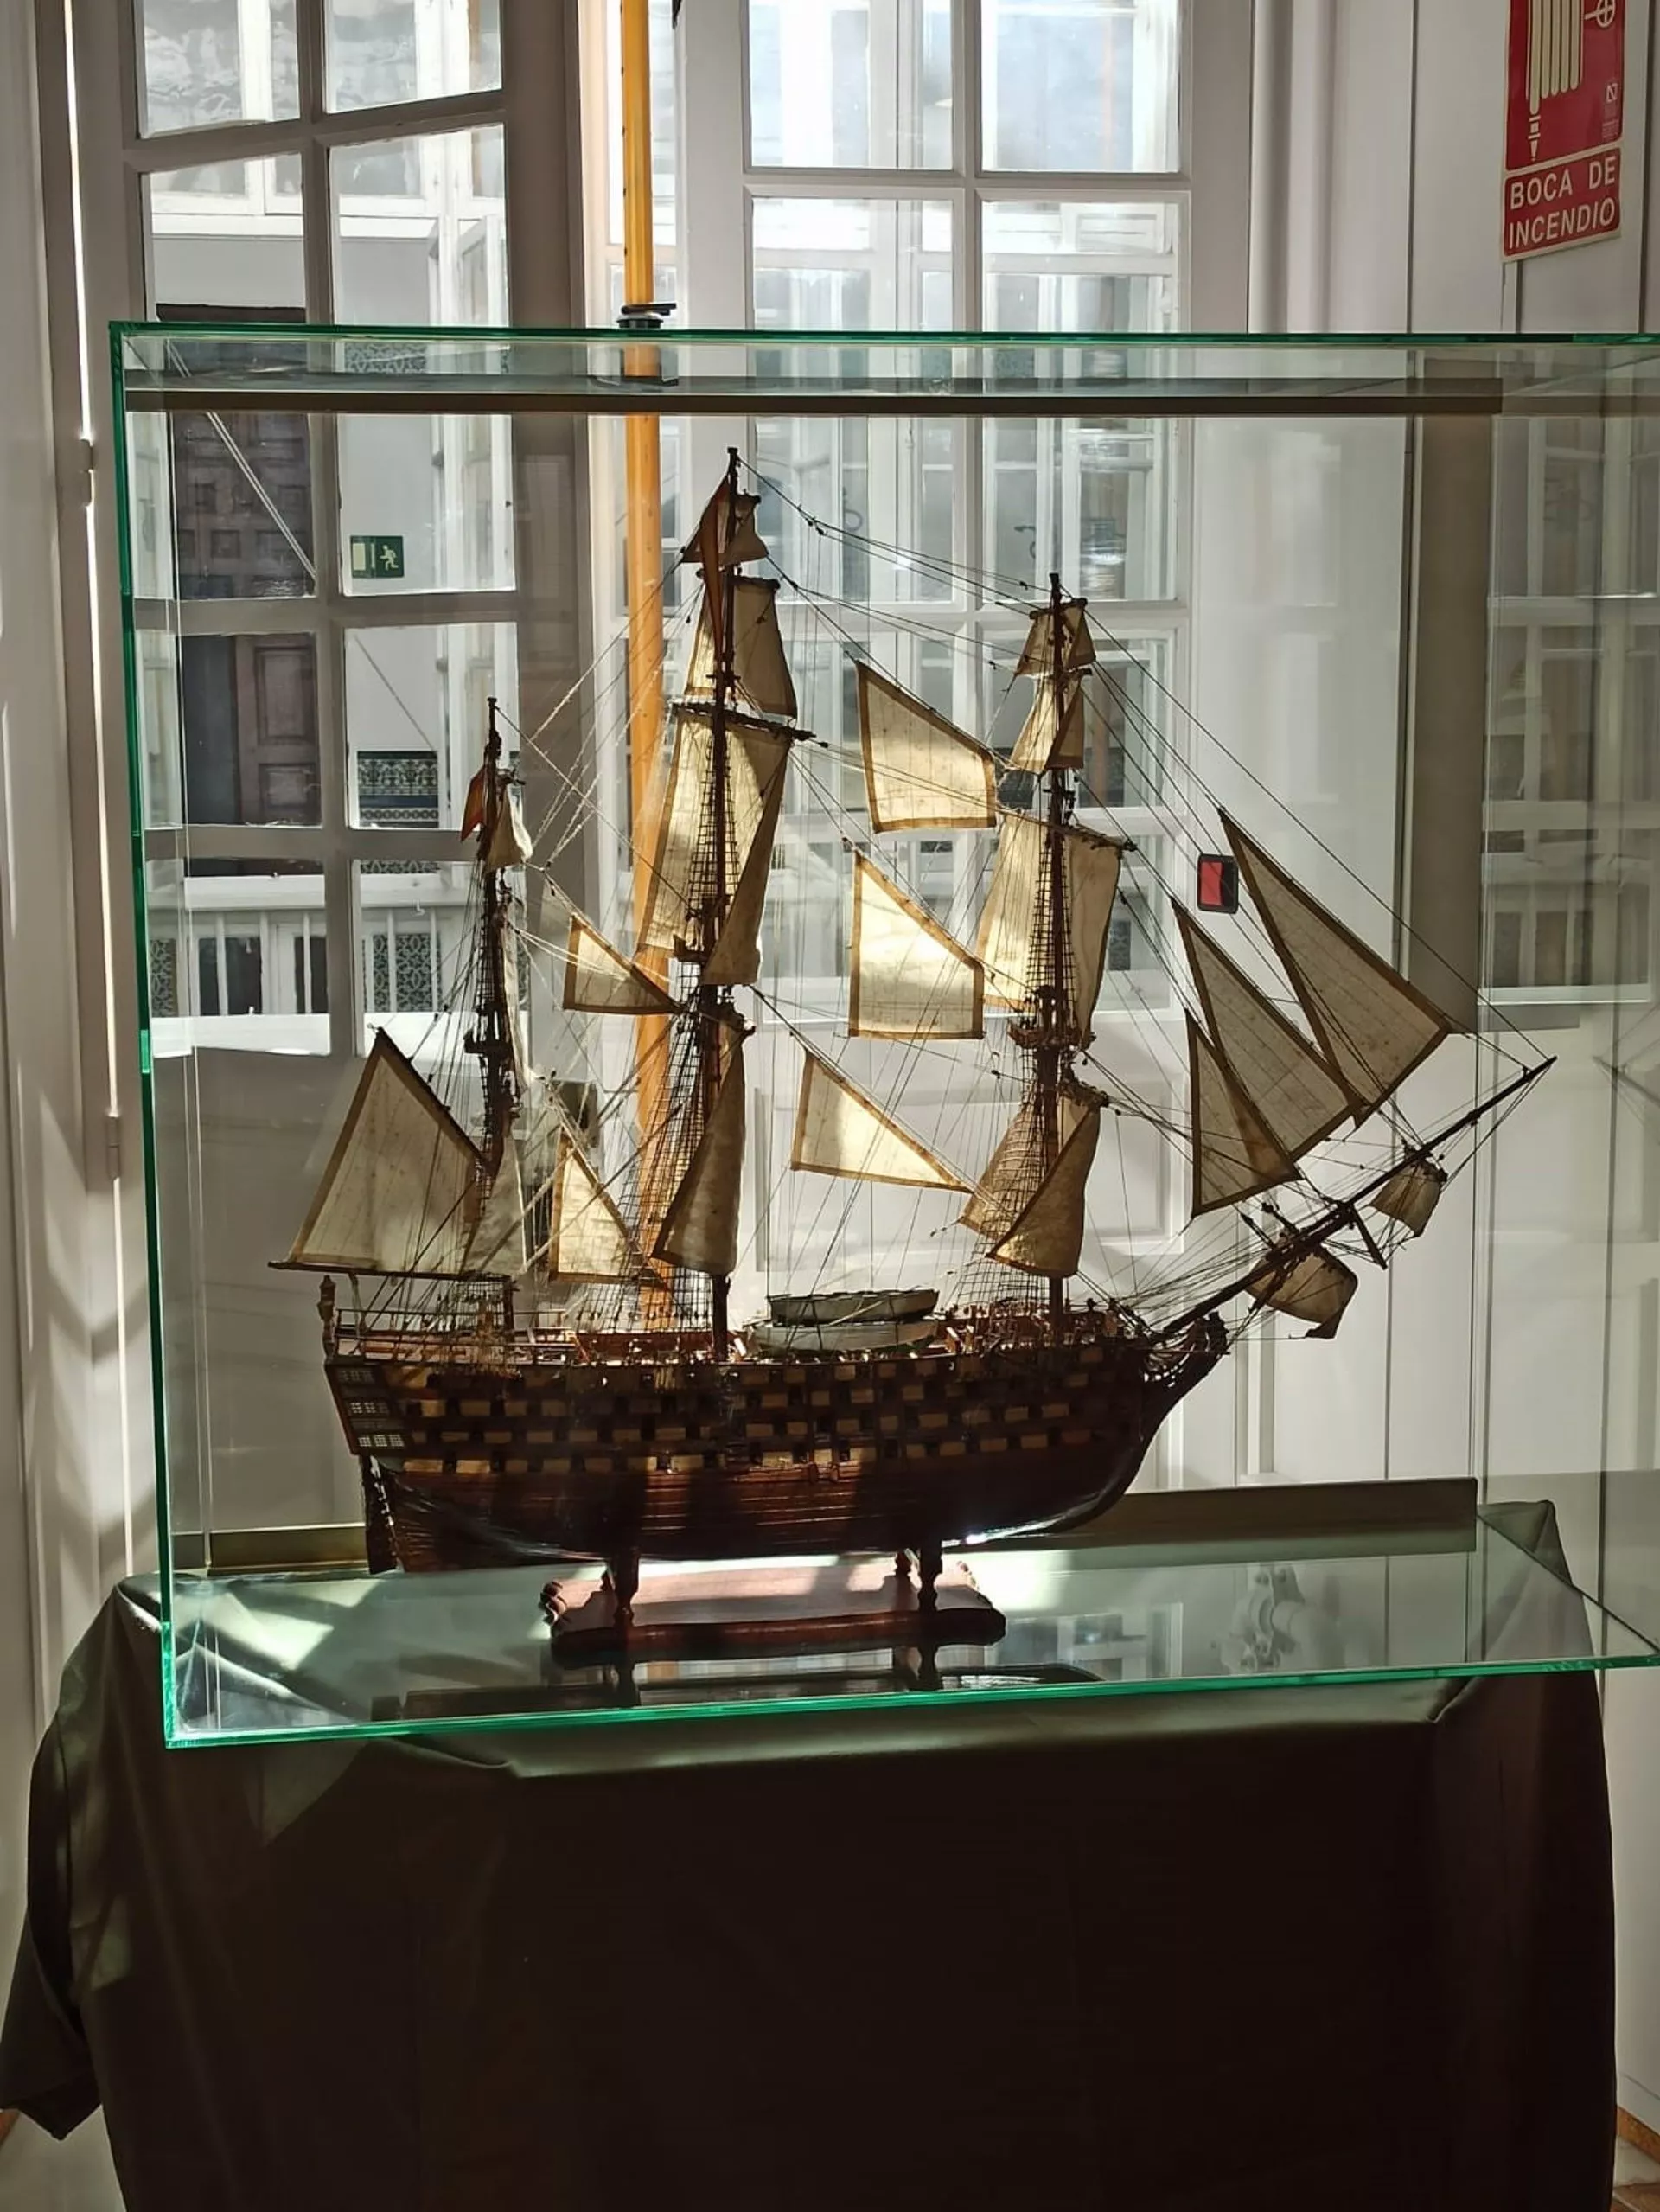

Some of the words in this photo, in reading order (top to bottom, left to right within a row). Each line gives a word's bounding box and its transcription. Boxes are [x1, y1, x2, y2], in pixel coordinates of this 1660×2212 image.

[1510, 169, 1573, 209] BOCA
[1588, 155, 1617, 189] DE
[1509, 198, 1615, 250] INCENDIO
